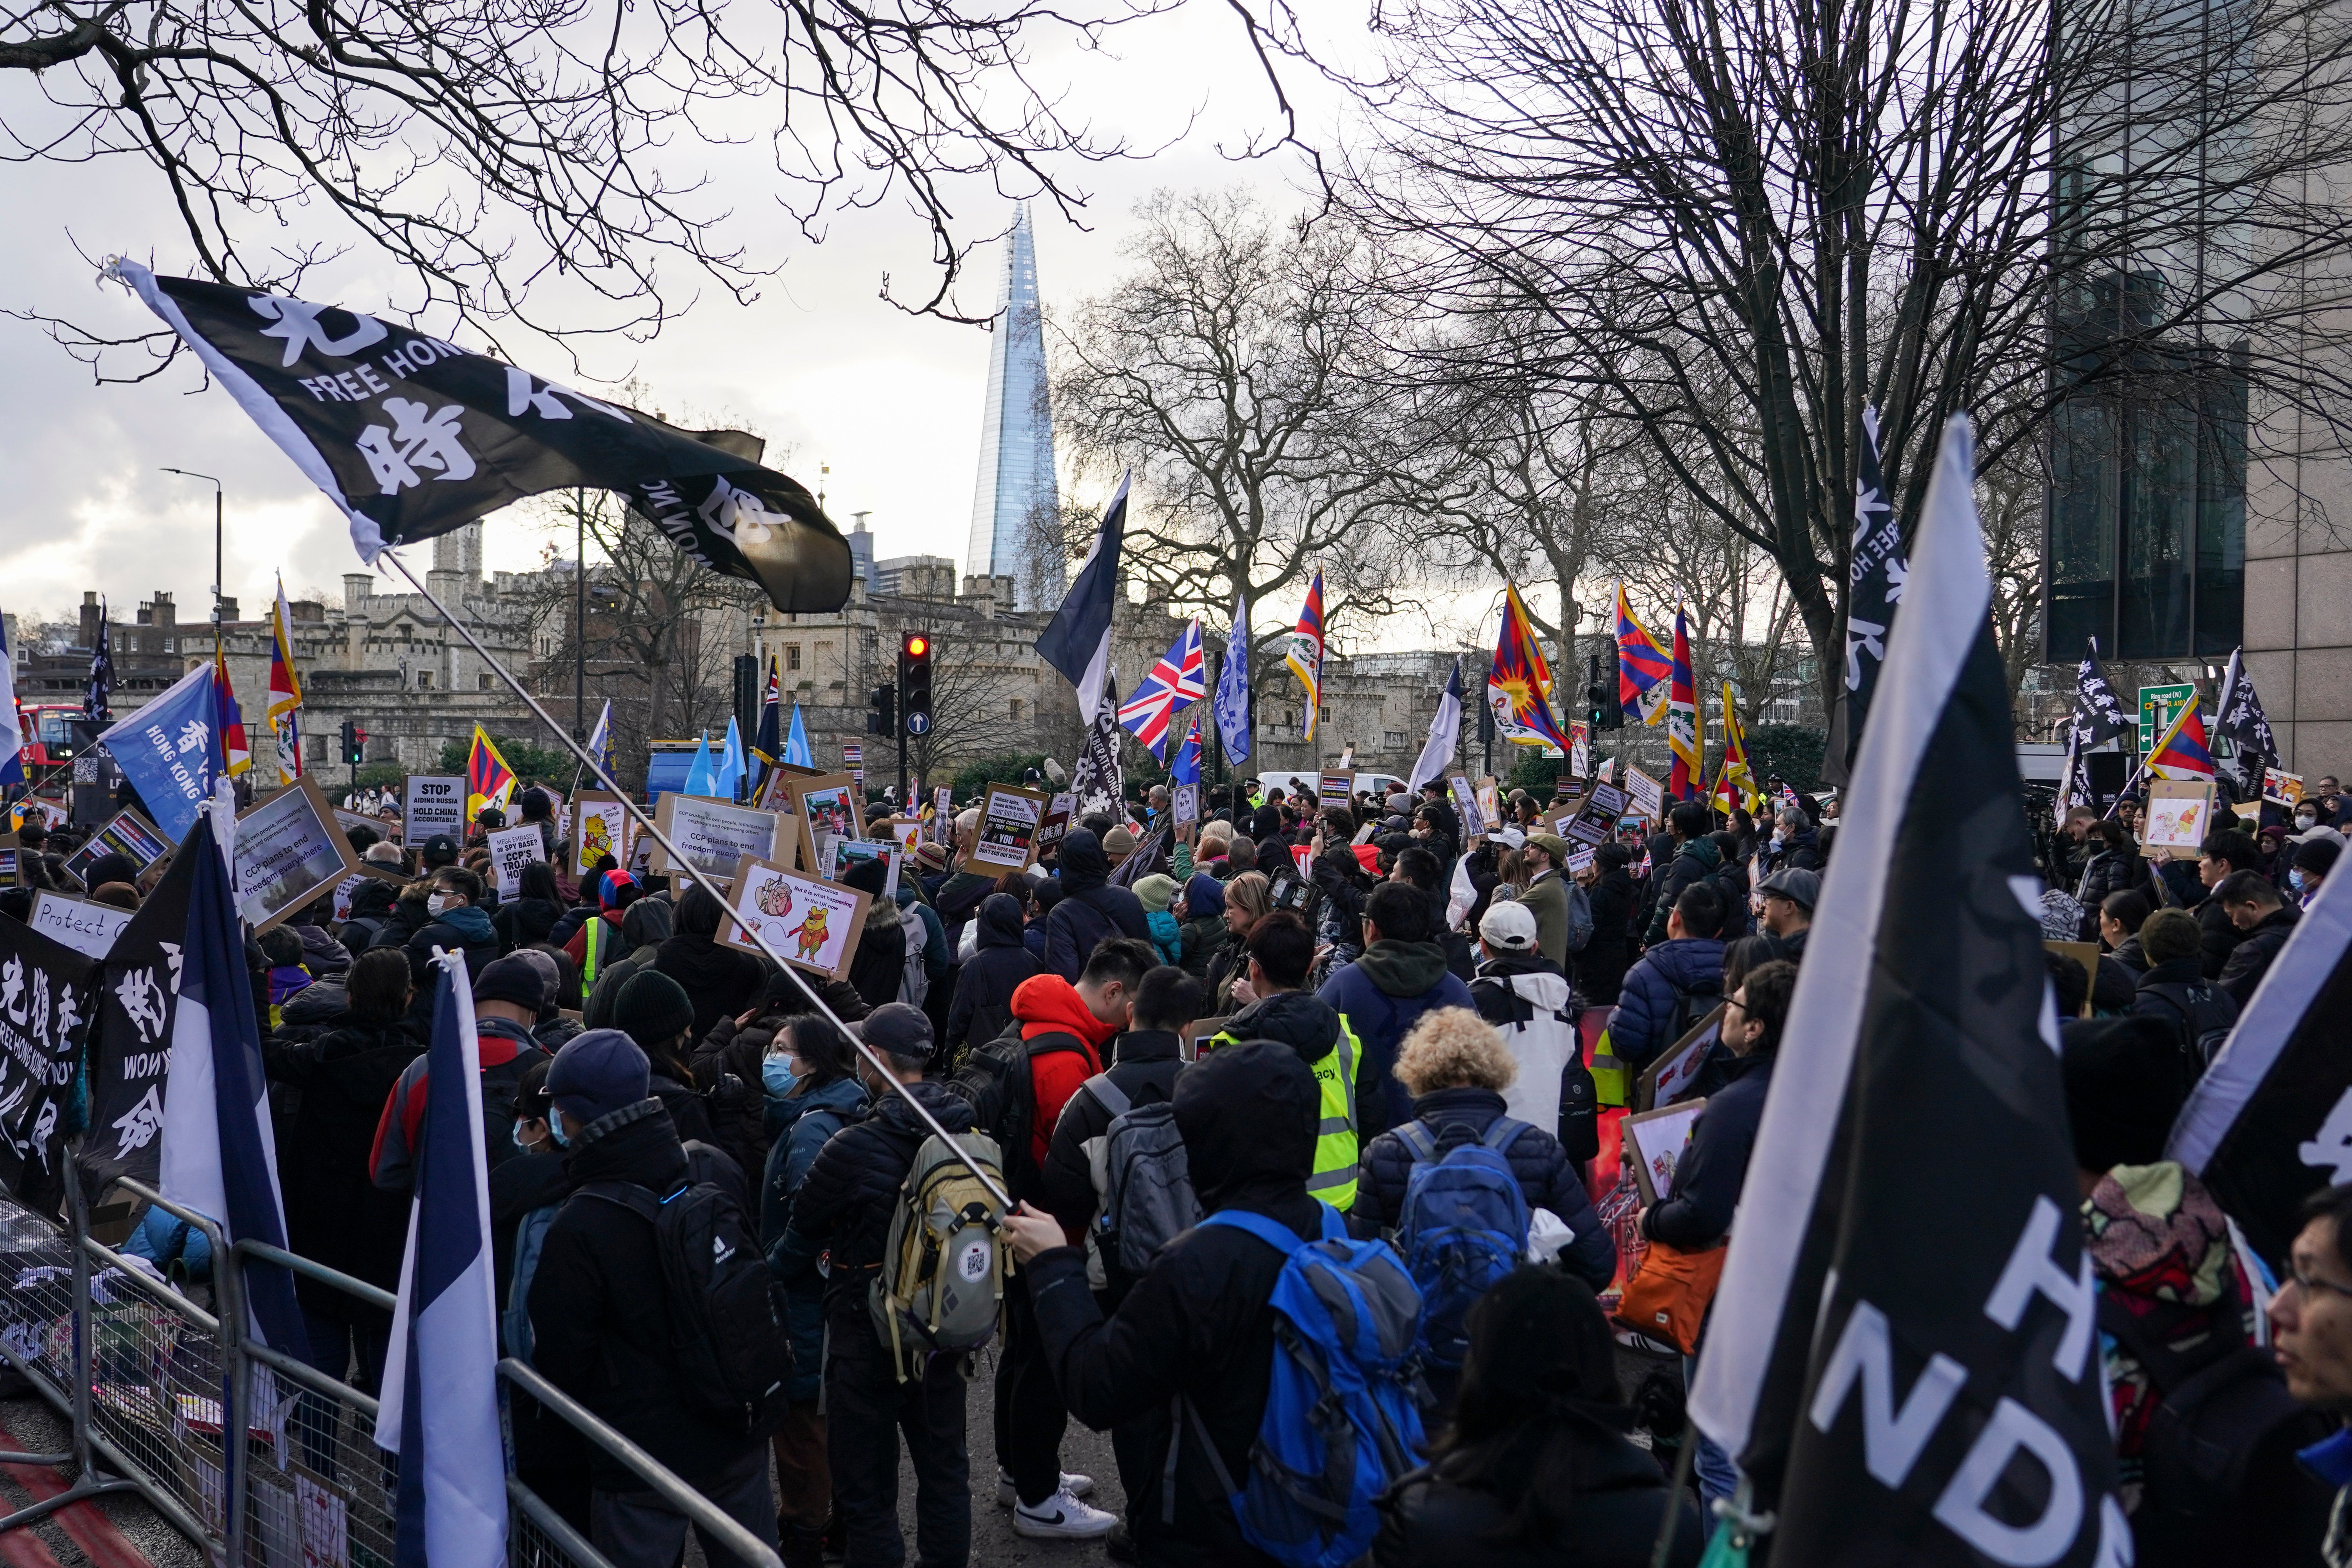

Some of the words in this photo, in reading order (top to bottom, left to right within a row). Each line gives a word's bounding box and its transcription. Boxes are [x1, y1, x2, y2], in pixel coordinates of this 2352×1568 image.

[298, 363, 390, 401] FREE
[382, 338, 484, 379] HON
[2079, 694, 2090, 706] HONG
[2087, 704, 2098, 717] KONG
[146, 725, 176, 762] HONG
[170, 761, 200, 799] KONG
[422, 784, 451, 795] STOP
[1105, 769, 1119, 796] HONG
[2074, 775, 2086, 795] FREE
[260, 823, 277, 836] people,
[276, 808, 302, 825] intimidating
[688, 818, 711, 827] neighbours
[721, 825, 745, 834] oppressing
[739, 822, 764, 831] intimidating
[1590, 817, 1602, 826] YOU
[264, 825, 289, 842] oppressing
[288, 817, 301, 828] others
[512, 833, 535, 842] EMBASSY
[519, 839, 537, 848] BASE?
[690, 833, 706, 841] CCP
[708, 836, 728, 845] plans
[1000, 833, 1014, 845] YOU
[1014, 837, 1029, 847] PAY
[682, 842, 713, 854] freedom
[997, 846, 1025, 855] SUPER-EMBASSY
[1577, 843, 1589, 851] YOU
[245, 863, 261, 878] CCP
[263, 851, 283, 869] plans
[283, 845, 292, 854] to
[294, 834, 309, 848] end
[506, 849, 532, 861] CCP'S
[245, 872, 279, 896] freedom
[278, 844, 322, 875] everywhere
[813, 884, 839, 896] Ridiculous
[826, 895, 853, 908] happening
[40, 904, 103, 936] Protect
[14, 1033, 33, 1070] HONG
[28, 1048, 47, 1081] KONG
[715, 1247, 736, 1264] deuter
